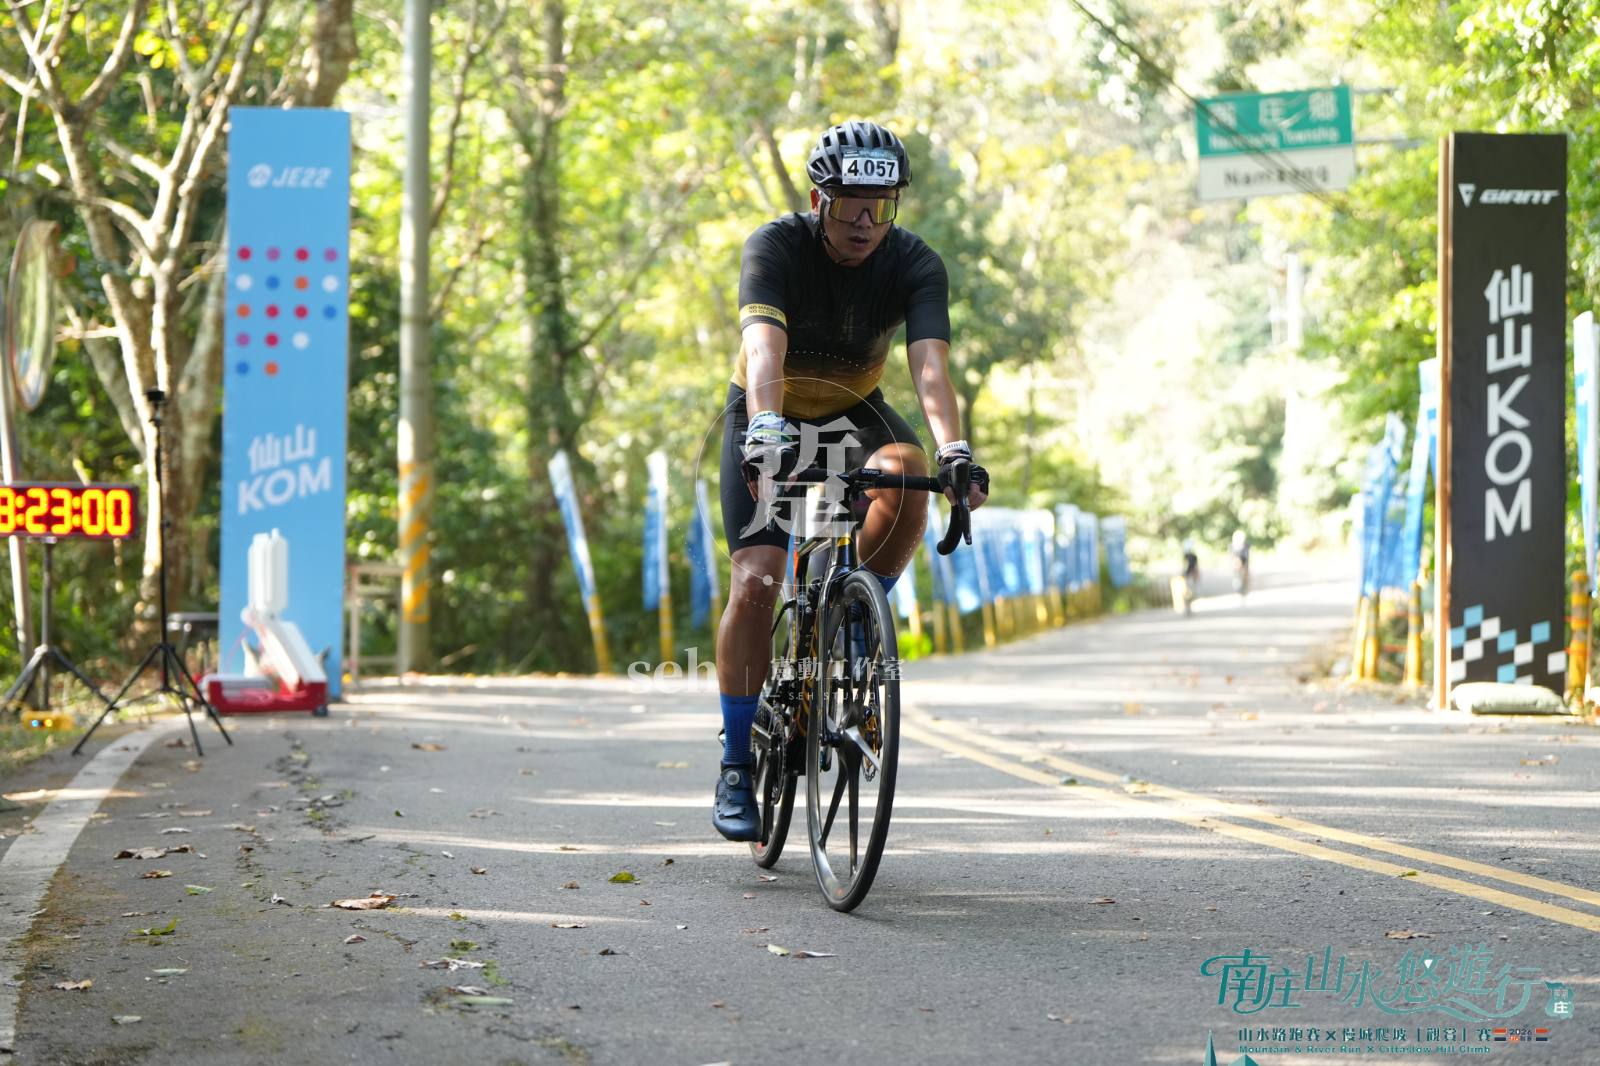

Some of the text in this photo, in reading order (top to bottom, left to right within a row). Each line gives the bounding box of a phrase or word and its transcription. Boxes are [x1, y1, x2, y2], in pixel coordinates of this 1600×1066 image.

[272, 167, 332, 188] JE22
[1480, 189, 1560, 205] GIANT
[248, 424, 316, 474] 仙山
[238, 458, 333, 514] KOM
